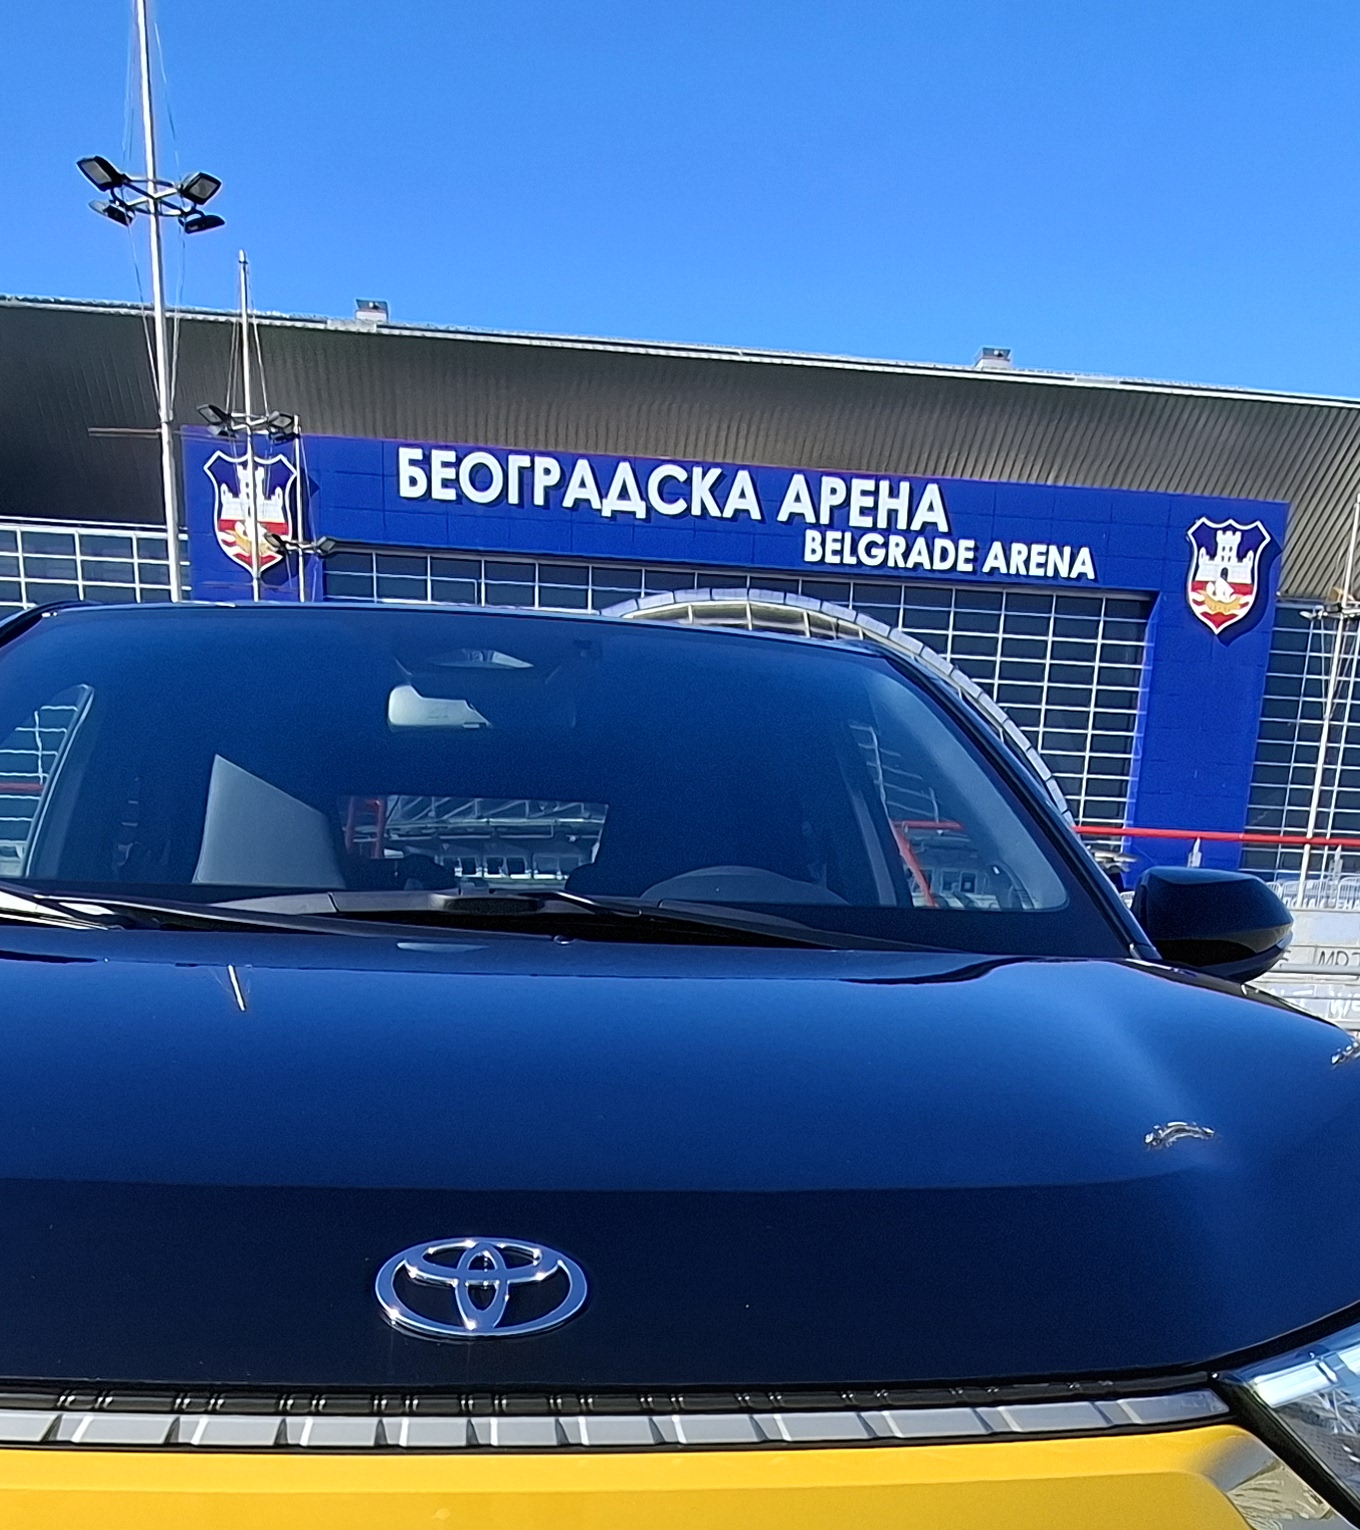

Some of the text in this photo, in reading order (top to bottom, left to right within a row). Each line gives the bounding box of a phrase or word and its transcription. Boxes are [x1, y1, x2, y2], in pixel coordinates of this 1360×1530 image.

[397, 446, 950, 533] БЕОГРАДСКА АРЕНА
[803, 529, 1095, 580] BELGRADE ARENA
